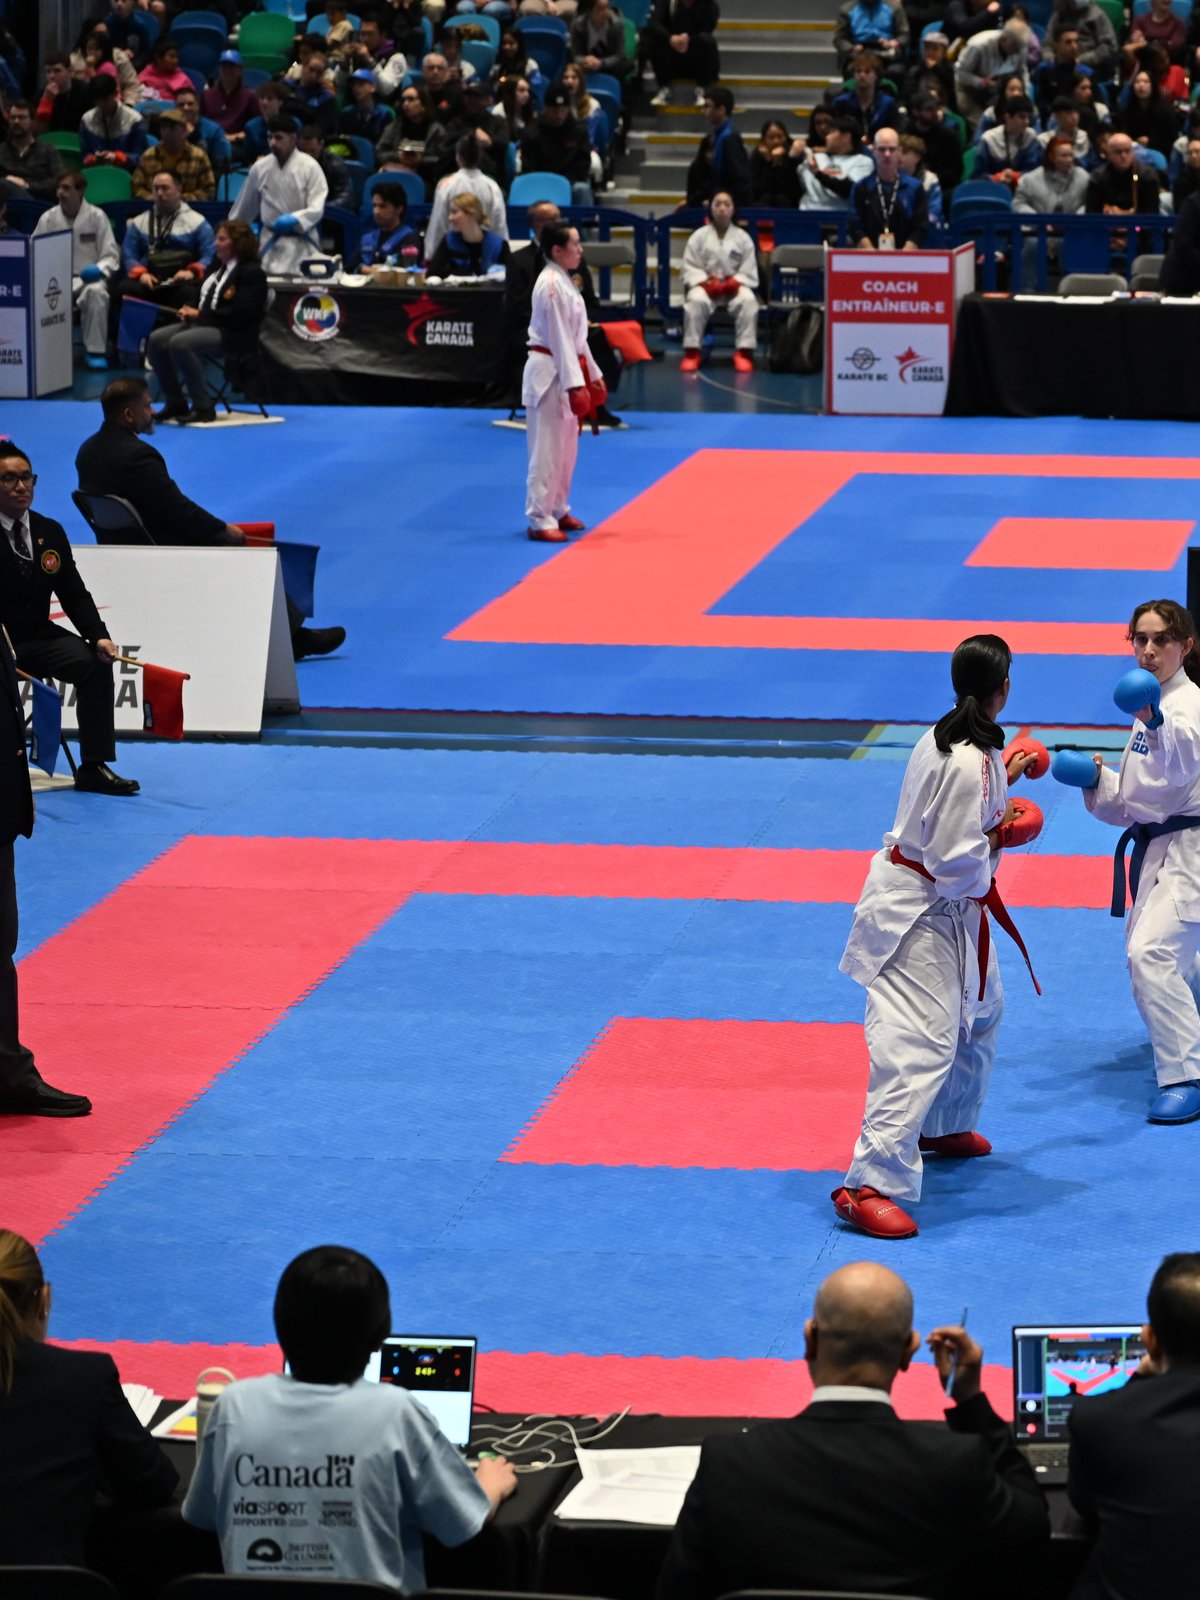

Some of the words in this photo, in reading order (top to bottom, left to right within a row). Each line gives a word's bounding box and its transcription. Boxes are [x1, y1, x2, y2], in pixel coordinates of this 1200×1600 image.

[862, 280, 918, 293] COACH
[303, 307, 330, 320] WKF
[426, 321, 474, 333] KARATE
[425, 334, 474, 346] CANADA
[912, 366, 943, 374] KARATE
[837, 373, 873, 381] KARATE
[912, 374, 944, 382] CANADA
[235, 1453, 354, 1488] Canada
